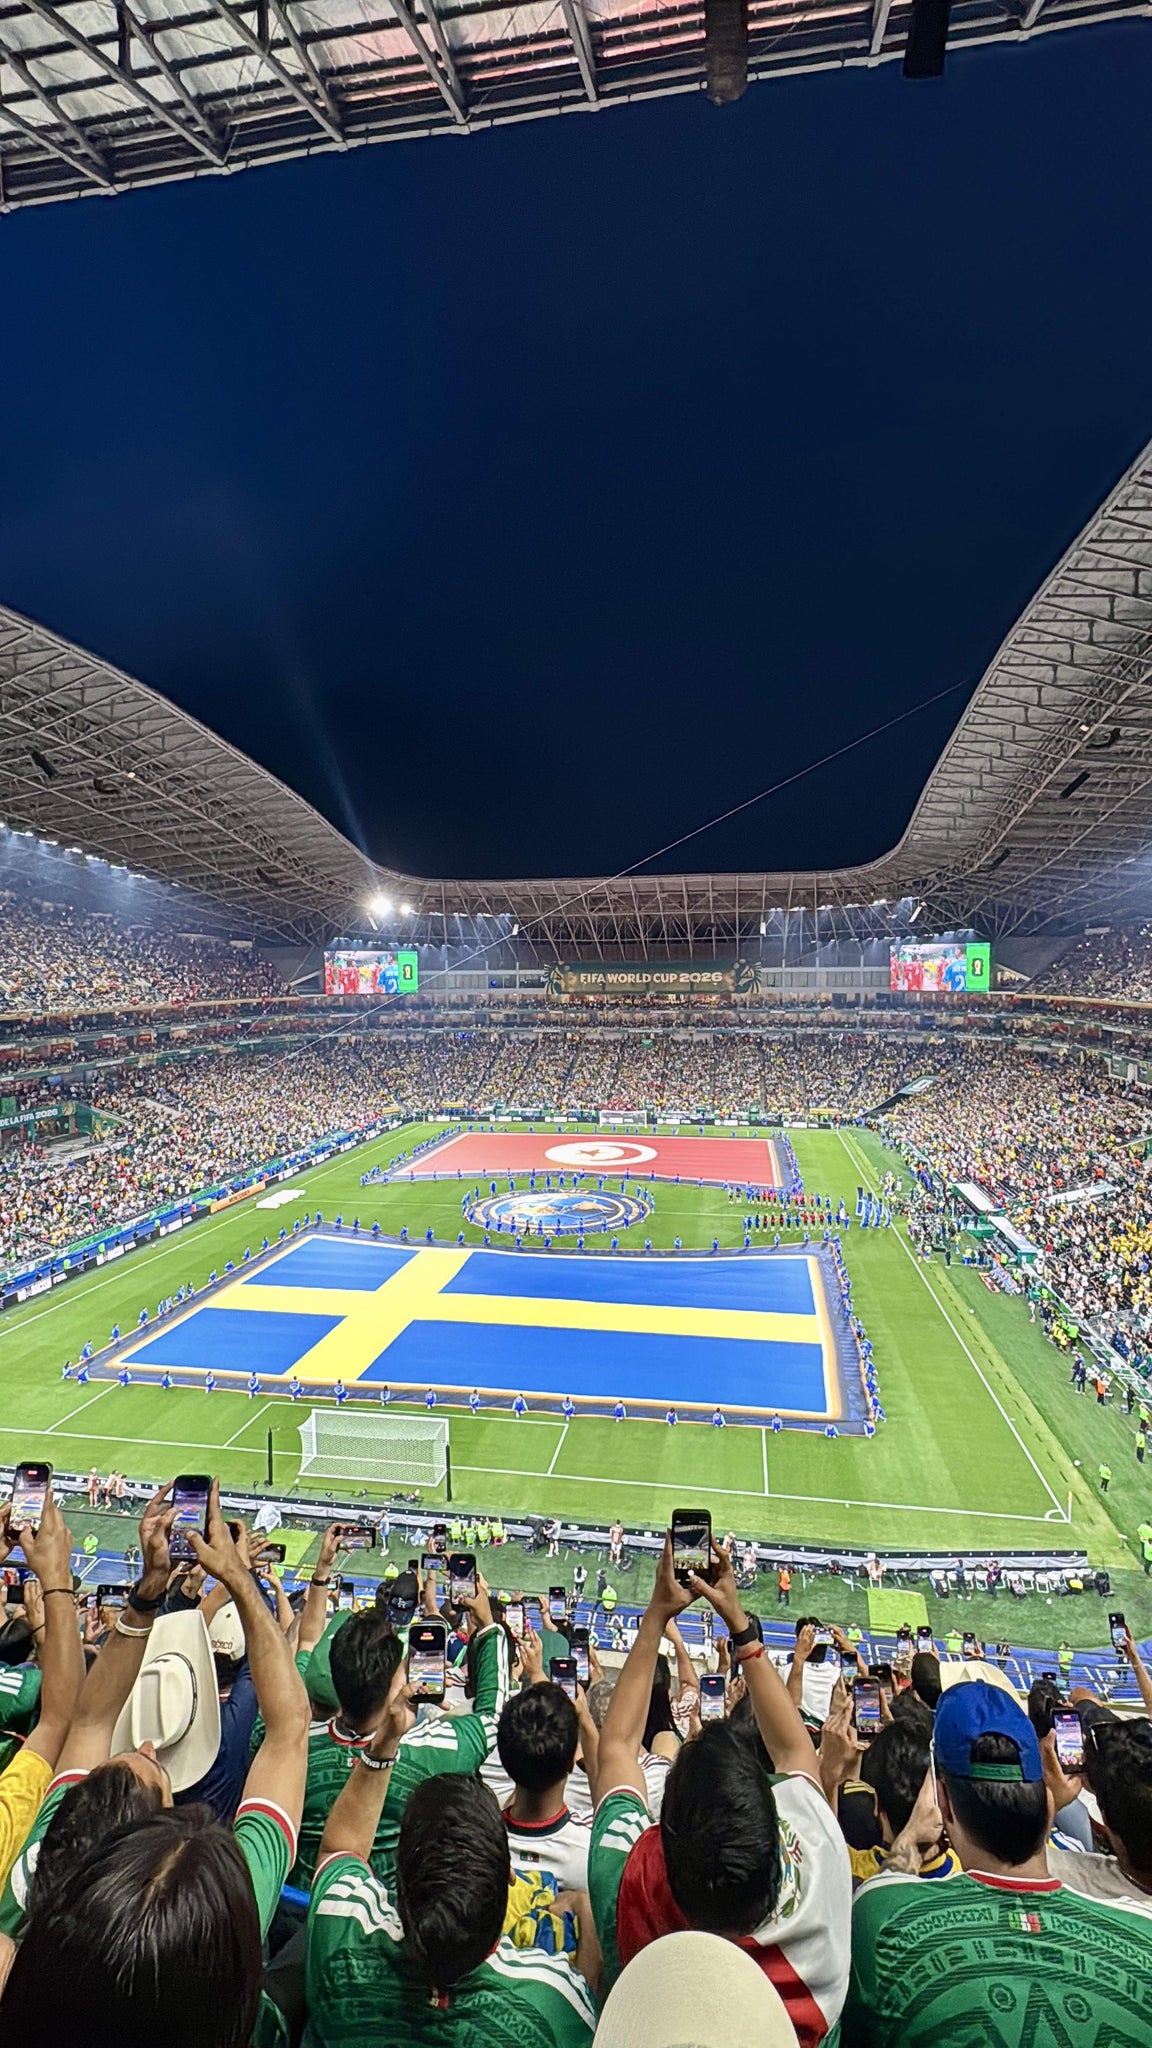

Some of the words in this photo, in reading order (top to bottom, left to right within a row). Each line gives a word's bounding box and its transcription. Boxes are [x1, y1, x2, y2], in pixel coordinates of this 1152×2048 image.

[580, 972, 605, 983] FIFA
[607, 972, 650, 983] WORLD
[653, 972, 677, 983] CUP
[679, 972, 723, 983] 2026
[9, 1116, 19, 1125] LA
[20, 1113, 35, 1122] FIFA
[35, 1108, 58, 1119] 2026
